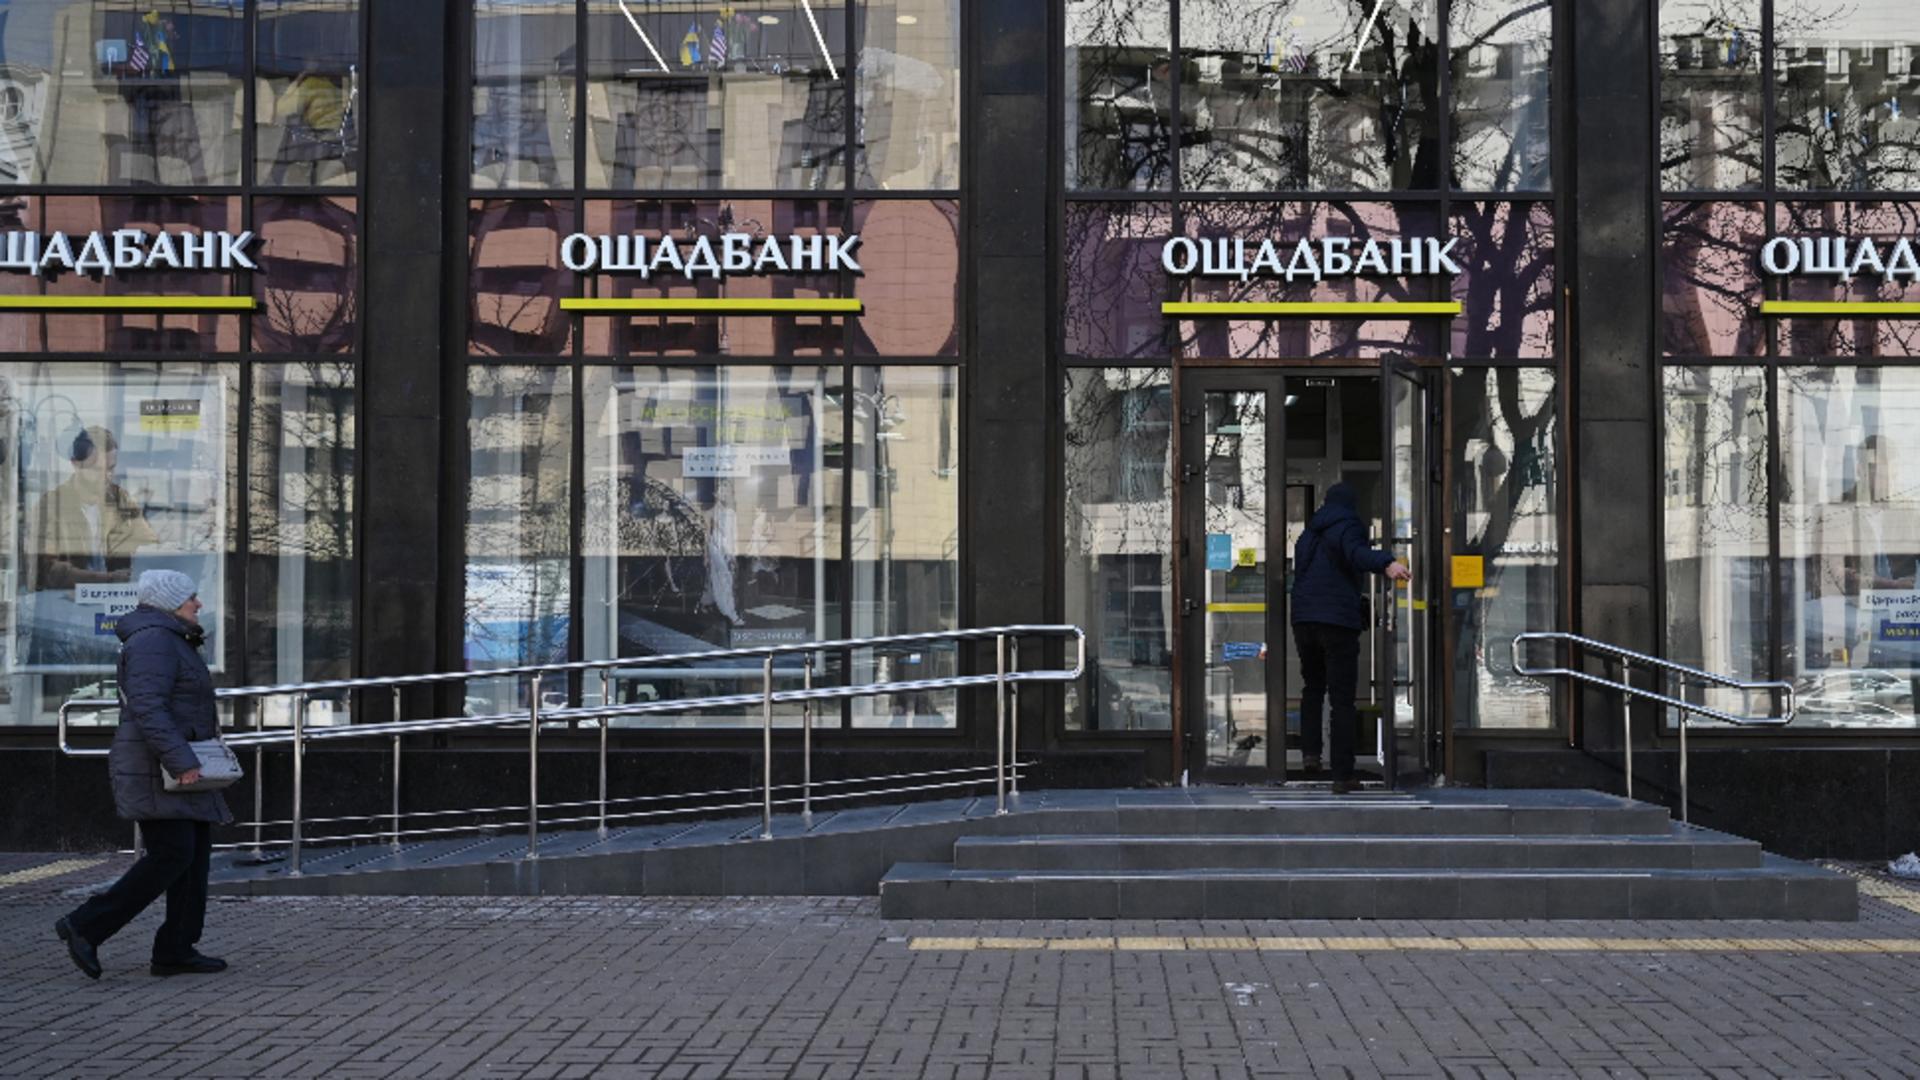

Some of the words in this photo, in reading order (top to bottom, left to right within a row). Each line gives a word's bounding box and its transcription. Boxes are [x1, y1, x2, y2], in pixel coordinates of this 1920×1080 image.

[560, 232, 862, 280] ОЩАДБАНК
[1161, 236, 1462, 282] ОЩАДБАНК
[1761, 236, 1920, 282] ОЩАД
